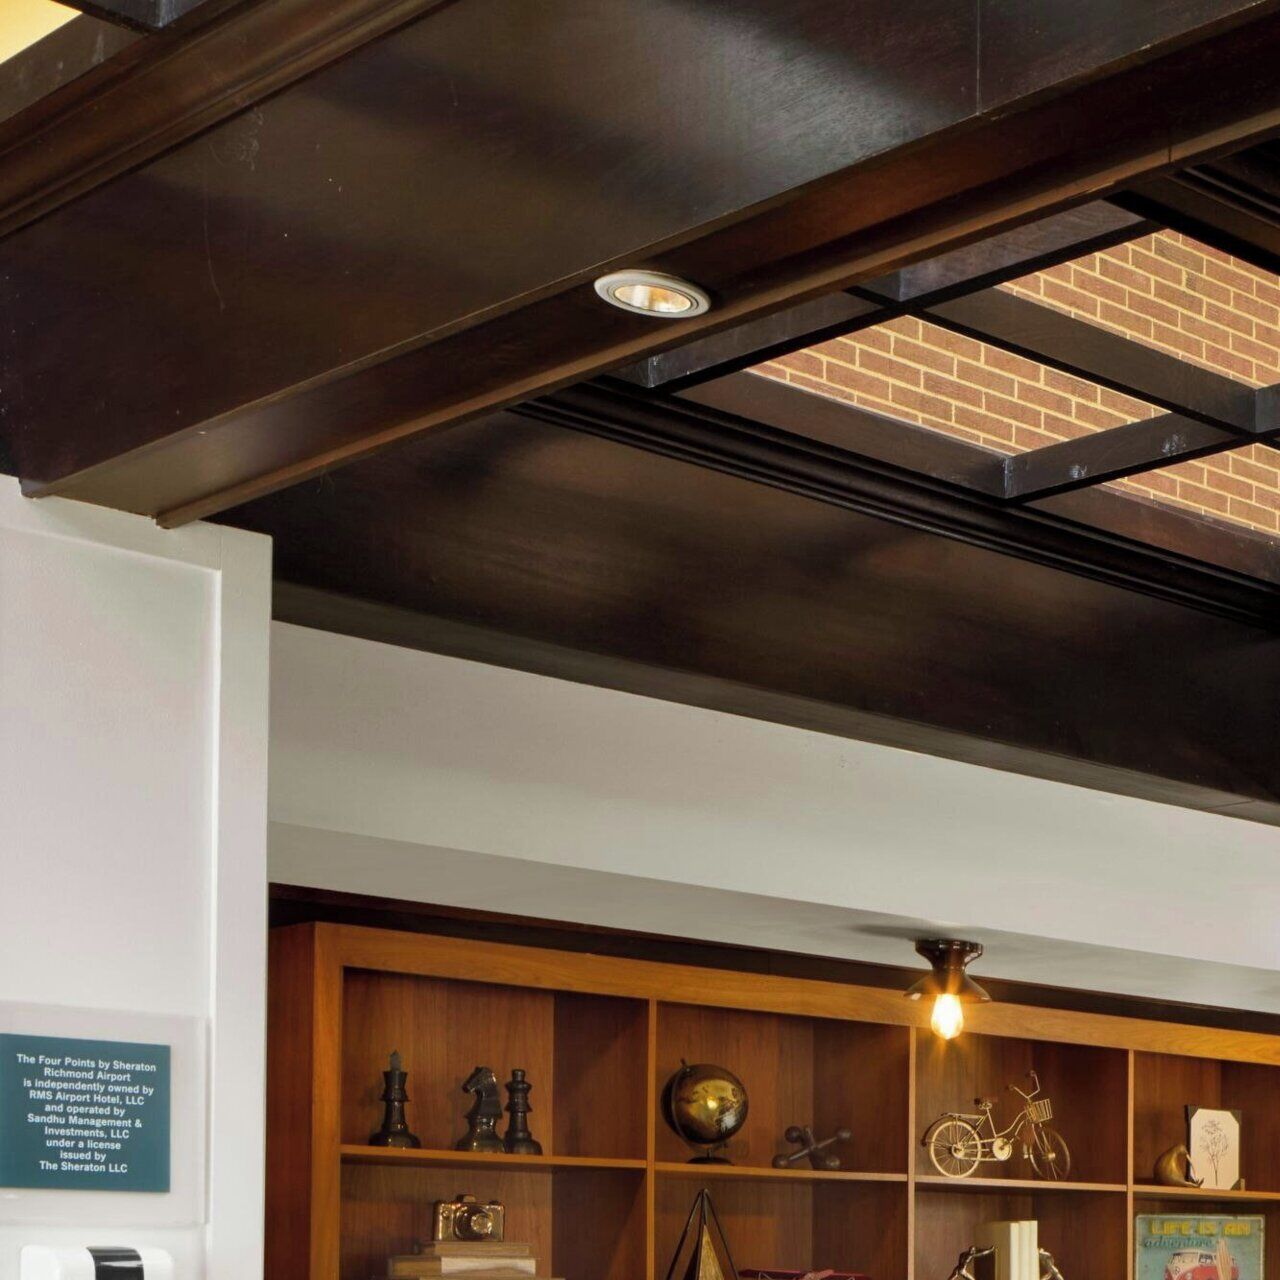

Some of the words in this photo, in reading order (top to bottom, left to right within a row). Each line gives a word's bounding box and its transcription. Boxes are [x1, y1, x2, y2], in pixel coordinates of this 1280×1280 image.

[16, 1053, 36, 1064] The
[38, 1055, 61, 1066] Four
[64, 1057, 96, 1068] Points
[98, 1059, 111, 1070] by
[112, 1060, 157, 1072] Sheraton
[44, 1067, 94, 1080] Richmond
[96, 1071, 131, 1083] Airport
[23, 1079, 32, 1088] is
[35, 1079, 105, 1093] independently
[107, 1085, 140, 1094] owned
[142, 1086, 155, 1096] by
[29, 1090, 53, 1101] RMS
[55, 1092, 91, 1103] Airport
[93, 1093, 123, 1105] Hotel,
[125, 1095, 145, 1106] LLC
[44, 1102, 64, 1113] and
[66, 1104, 111, 1115] operated
[113, 1106, 126, 1117] by
[27, 1113, 66, 1125] Sandhu
[68, 1115, 132, 1128] Management
[134, 1119, 143, 1128] &
[44, 1126, 108, 1138] Investments,
[110, 1129, 130, 1139] LLC
[46, 1138, 75, 1148] under
[78, 1141, 85, 1149] a
[87, 1140, 122, 1150] license
[60, 1150, 91, 1160] issued
[94, 1151, 107, 1162] by
[39, 1160, 59, 1171] The
[61, 1161, 106, 1172] Sheraton
[108, 1163, 128, 1173] LLC
